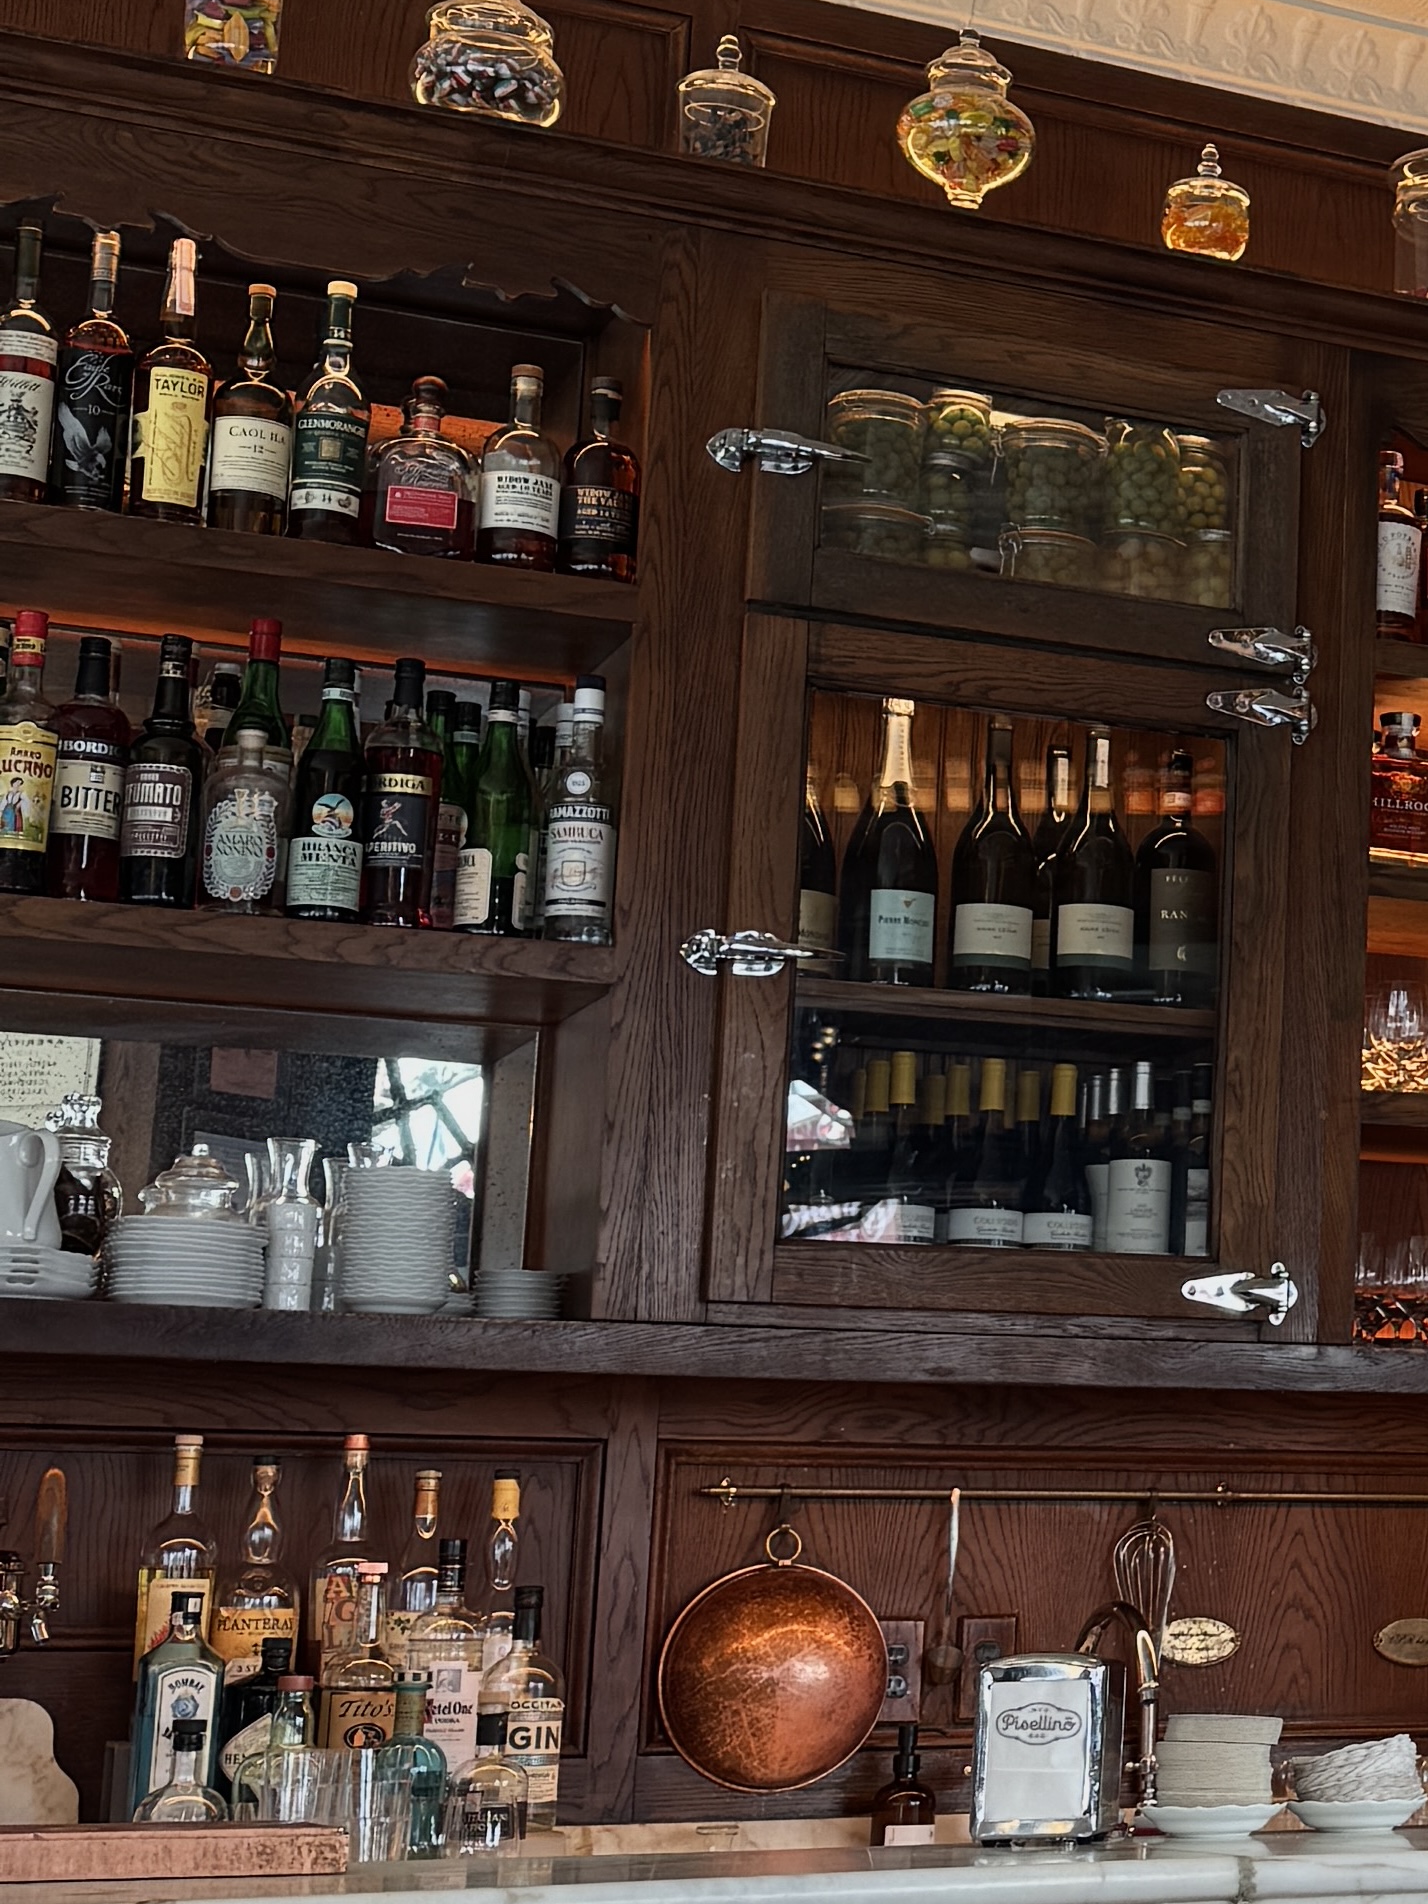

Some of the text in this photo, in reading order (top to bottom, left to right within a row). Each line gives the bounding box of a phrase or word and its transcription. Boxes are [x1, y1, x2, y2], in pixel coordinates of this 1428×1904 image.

[153, 377, 205, 399] TAYLOR
[87, 405, 101, 417] 10
[228, 425, 266, 441] CAOL
[9, 746, 42, 761] AMARO
[217, 834, 264, 846] AMARO
[301, 840, 357, 858] BRANCA
[301, 852, 357, 869] MENTA
[167, 1678, 206, 1694] BOMBAY
[338, 1699, 394, 1718] Tito's
[1002, 1713, 1076, 1732] Pisellino
[508, 1725, 560, 1750] GIN
